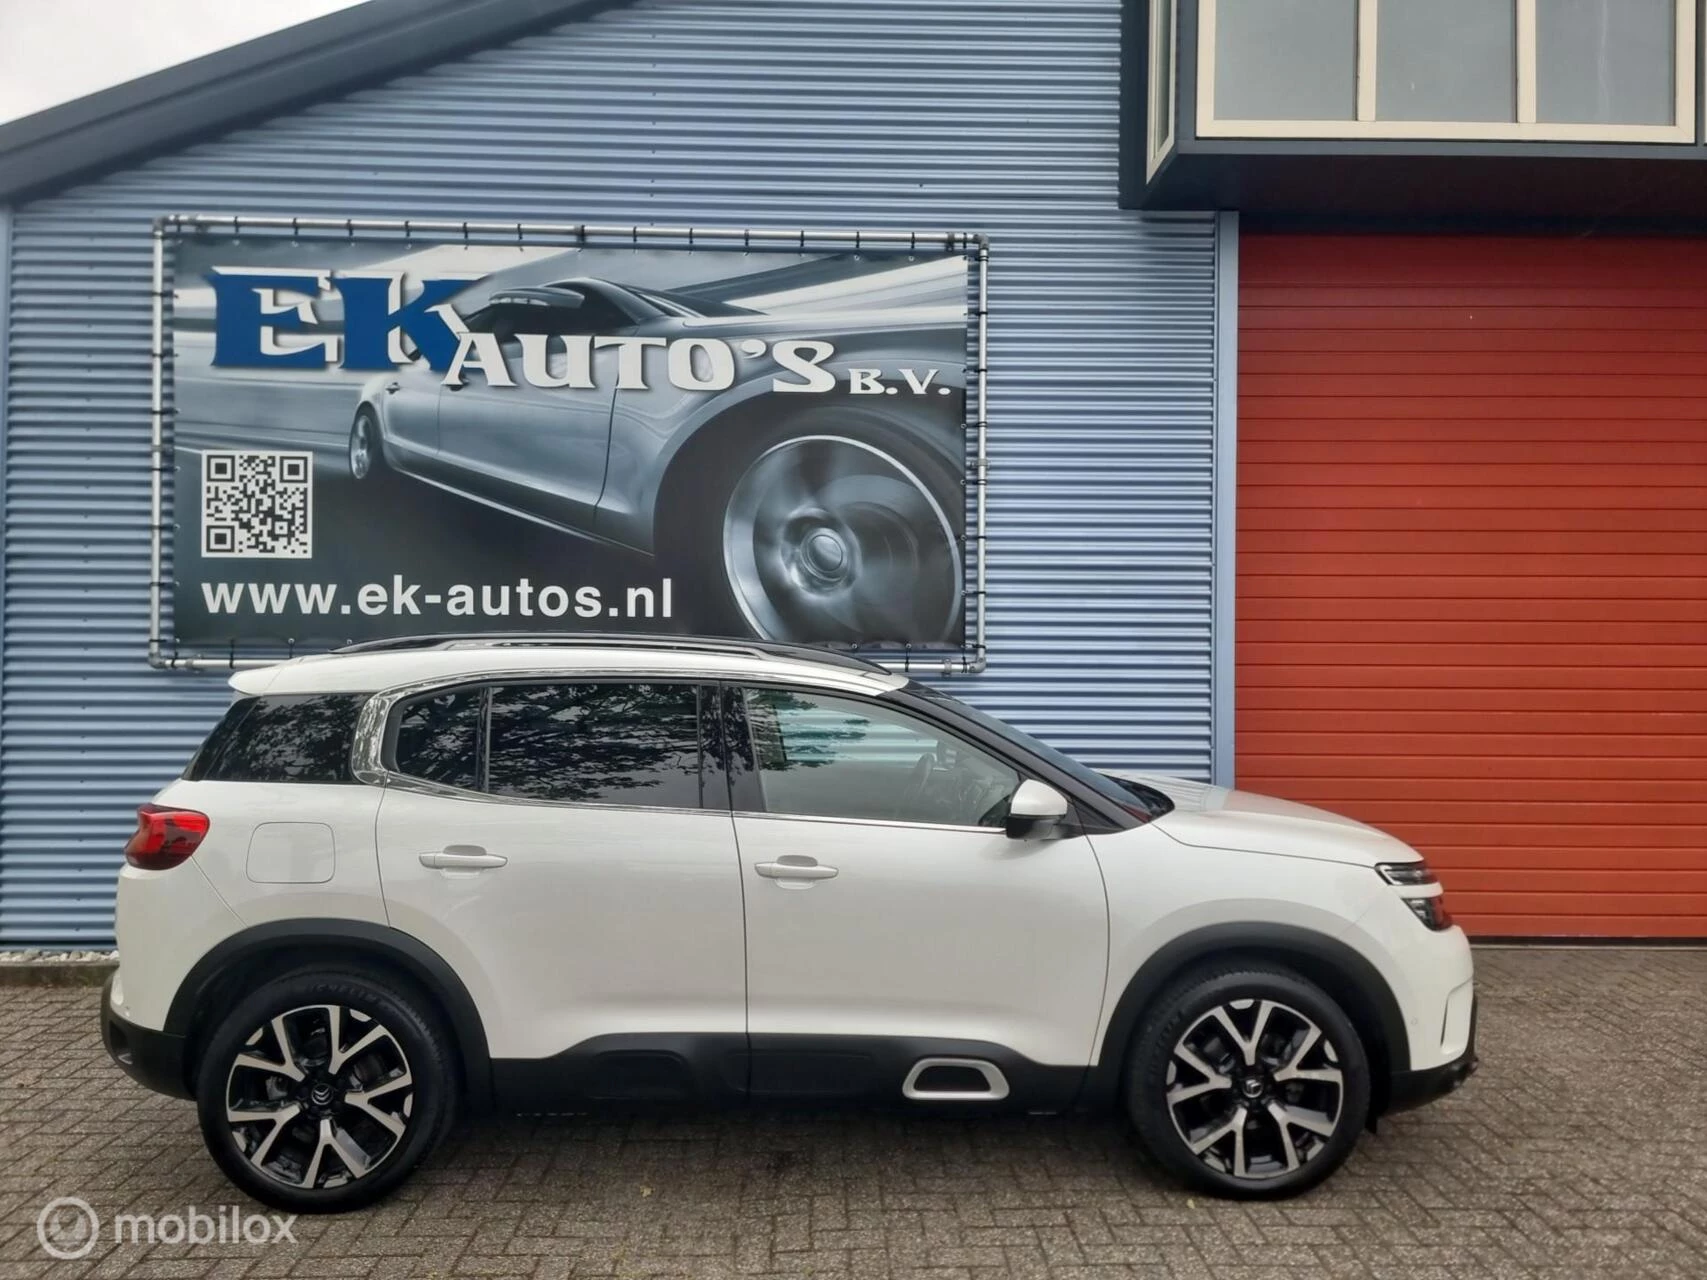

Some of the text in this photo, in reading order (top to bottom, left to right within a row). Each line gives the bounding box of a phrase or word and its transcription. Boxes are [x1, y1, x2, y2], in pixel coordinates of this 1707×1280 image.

[204, 265, 492, 370] EK
[848, 367, 952, 396] B.V.
[200, 574, 673, 618] www.ek-autos.nl
